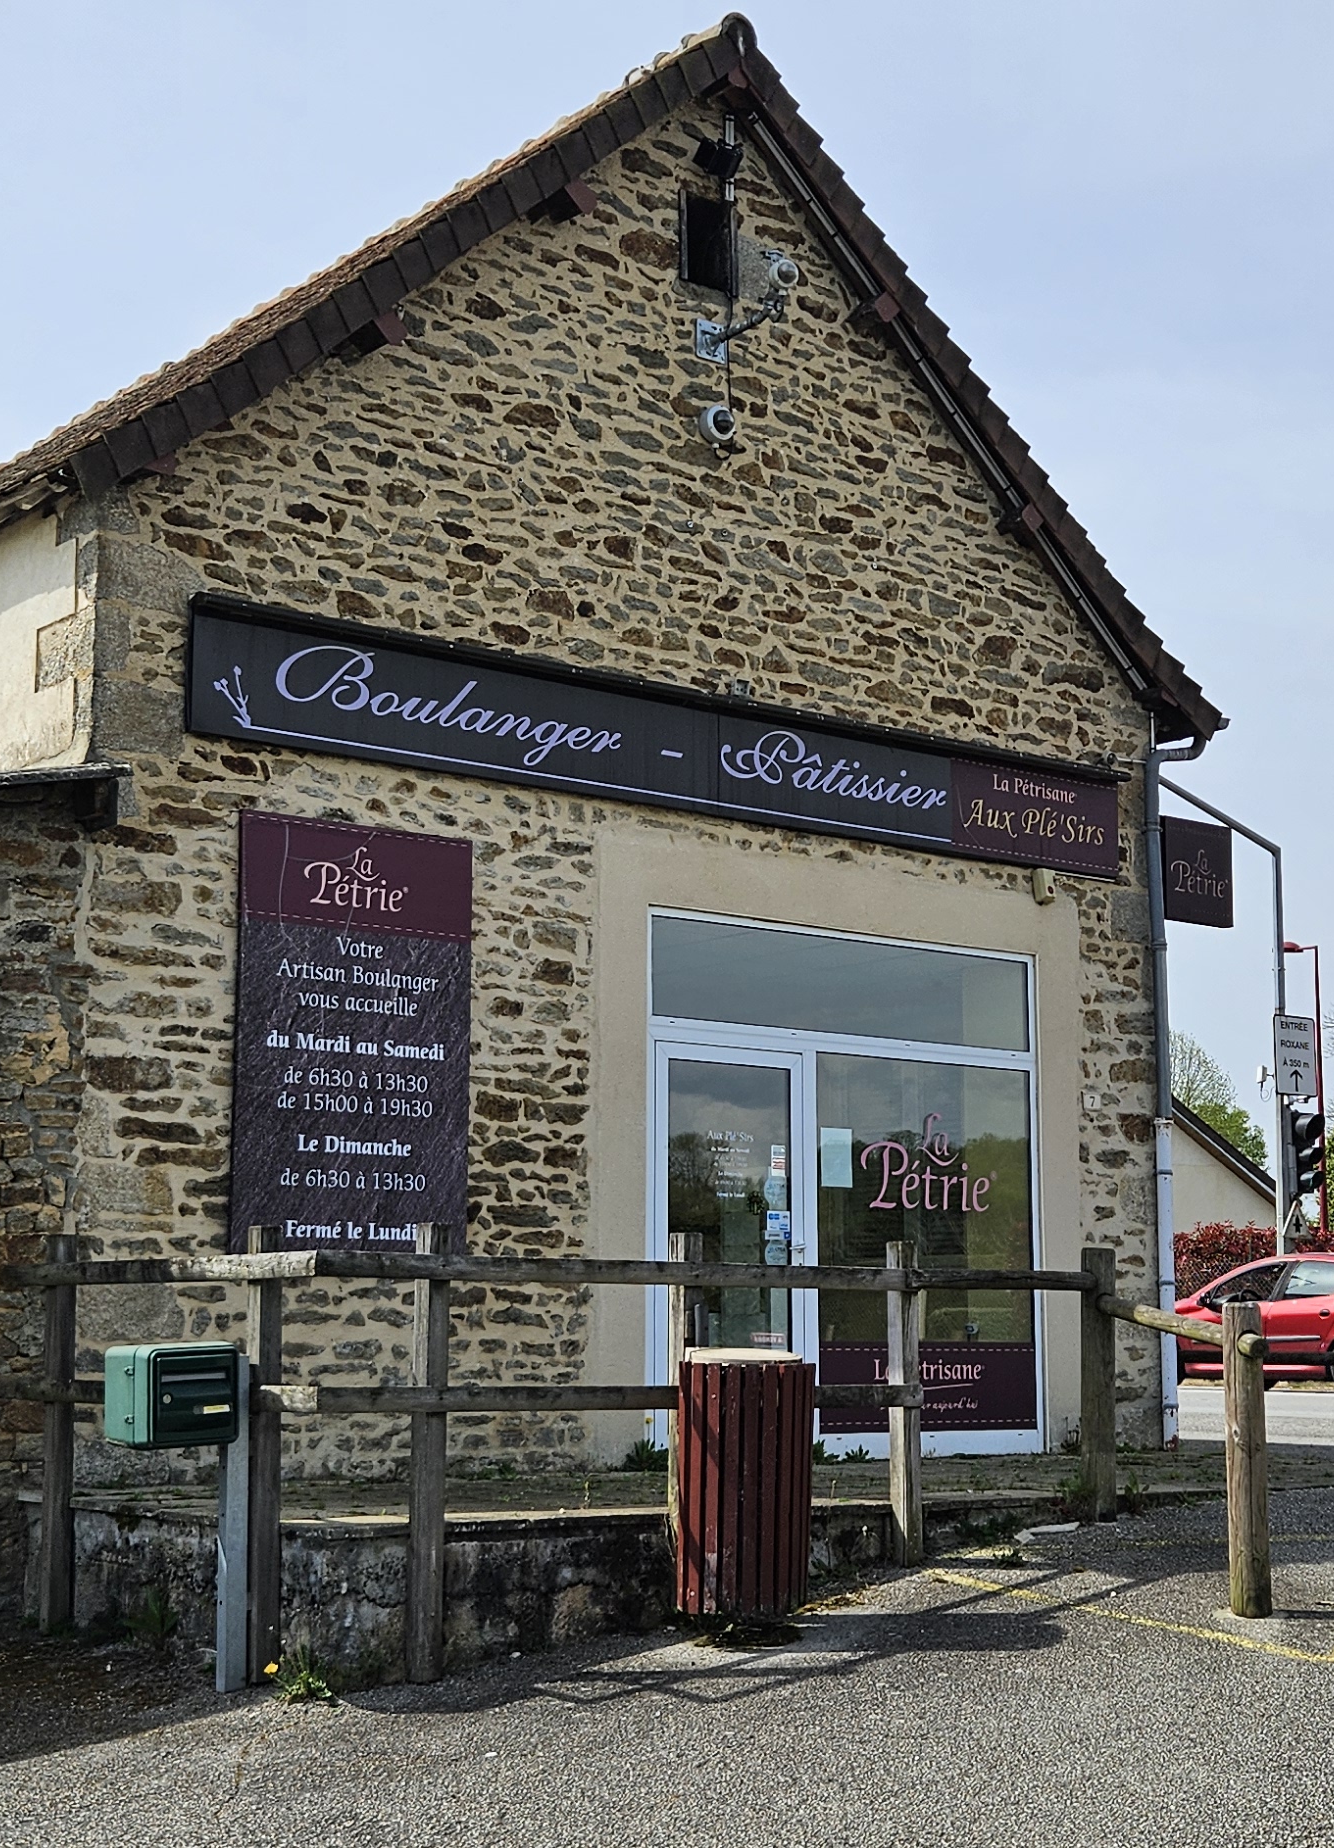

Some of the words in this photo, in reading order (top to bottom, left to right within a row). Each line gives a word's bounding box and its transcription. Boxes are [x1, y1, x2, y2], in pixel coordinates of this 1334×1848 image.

[275, 645, 622, 766] Boulanger
[720, 730, 947, 810] Pâtissier
[993, 773, 1009, 792] La
[1014, 777, 1075, 804] Pétrisane
[964, 799, 1017, 838] Aux
[1021, 807, 1105, 845] Plé'Sirs
[345, 846, 380, 881] La
[1194, 849, 1212, 875] La
[303, 861, 404, 912] Pétrie
[1170, 860, 1226, 898] Pétrie
[336, 935, 384, 960] Votre
[276, 957, 347, 984] Artisan
[351, 965, 440, 995] Boulanger
[298, 990, 340, 1010] vous
[344, 995, 418, 1017] accueille
[1280, 1020, 1309, 1032] ENTRÉE
[266, 1030, 290, 1049] du
[295, 1032, 351, 1053] Mardi
[356, 1040, 379, 1056] au
[383, 1040, 445, 1061] Samedi
[1280, 1039, 1310, 1051] ROXANE
[1289, 1058, 1302, 1068] 350
[1302, 1061, 1310, 1069] m
[284, 1066, 303, 1085] de
[308, 1067, 354, 1088] 6h30
[358, 1070, 369, 1089] à
[375, 1072, 429, 1093] 13h30
[277, 1091, 297, 1110] de
[303, 1093, 358, 1113] 15h00
[363, 1096, 374, 1114] à
[380, 1098, 434, 1118] 19h30
[297, 1133, 319, 1152] Le
[324, 1135, 413, 1157] Dimanche
[916, 1112, 960, 1167] La
[280, 1168, 300, 1187] de
[305, 1169, 351, 1189] 6h30
[355, 1171, 366, 1190] à
[372, 1172, 427, 1192] 13h30
[860, 1141, 991, 1213] Pétrie
[285, 1219, 342, 1240] Fermé
[346, 1222, 363, 1240] le
[368, 1223, 418, 1242] Lundi
[874, 1359, 890, 1380] L
